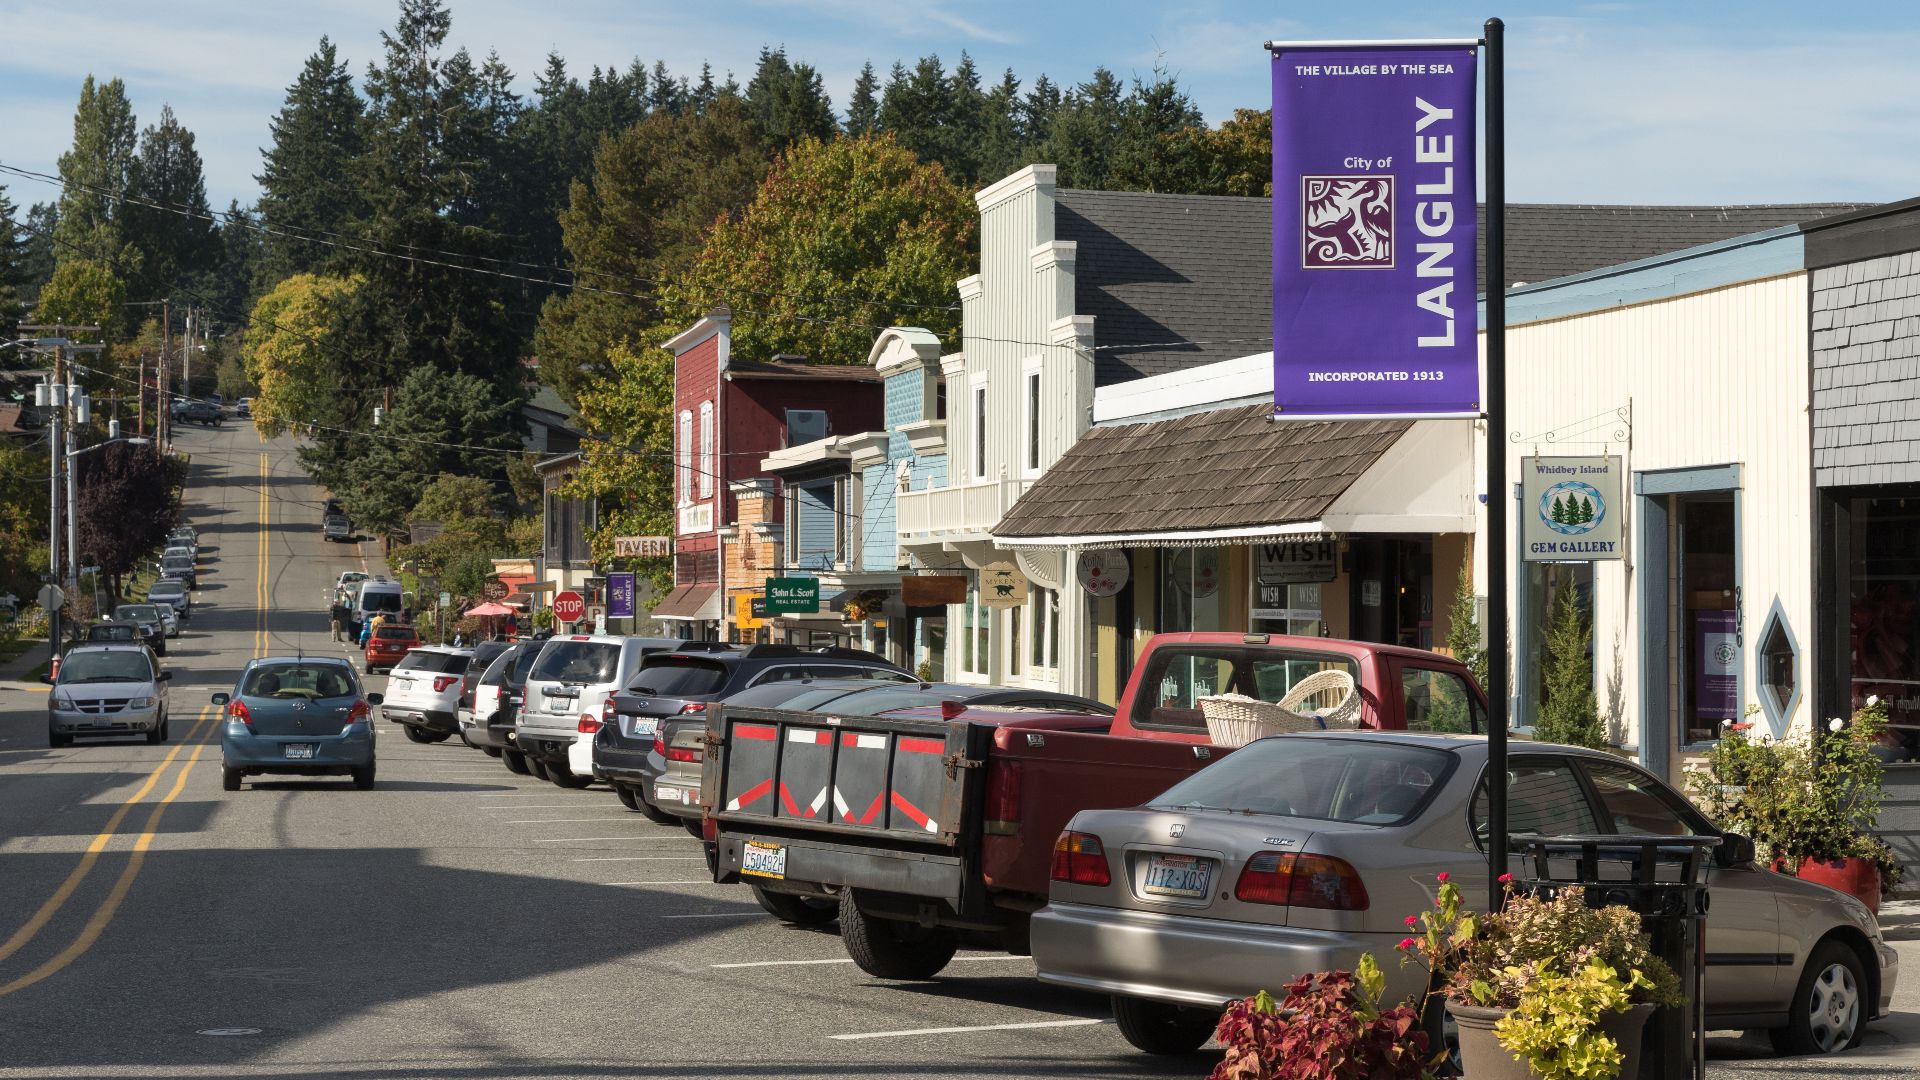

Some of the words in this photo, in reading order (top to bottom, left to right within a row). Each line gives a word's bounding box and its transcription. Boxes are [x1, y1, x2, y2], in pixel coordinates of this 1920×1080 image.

[1295, 66, 1320, 76] THE
[1323, 65, 1377, 76] VILLAGE
[1381, 65, 1398, 75] BY
[1401, 65, 1426, 75] THE
[1430, 64, 1454, 75] SEA
[1343, 157, 1372, 171] City
[1377, 157, 1393, 169] of
[1415, 95, 1455, 347] LANGLEY
[1308, 371, 1409, 382] INCORPORATED
[1412, 371, 1444, 381] 1913
[1535, 465, 1578, 475] Whidbey
[1580, 465, 1608, 474] Island
[616, 540, 667, 554] TAVERN
[1263, 544, 1332, 563] WISH
[1530, 542, 1557, 553] GEM
[1559, 541, 1616, 553] GALLERY
[490, 589, 506, 599] Eyes
[770, 587, 789, 598] John
[797, 587, 815, 598] Scott
[1261, 586, 1279, 603] WISH
[555, 601, 583, 616] STOP
